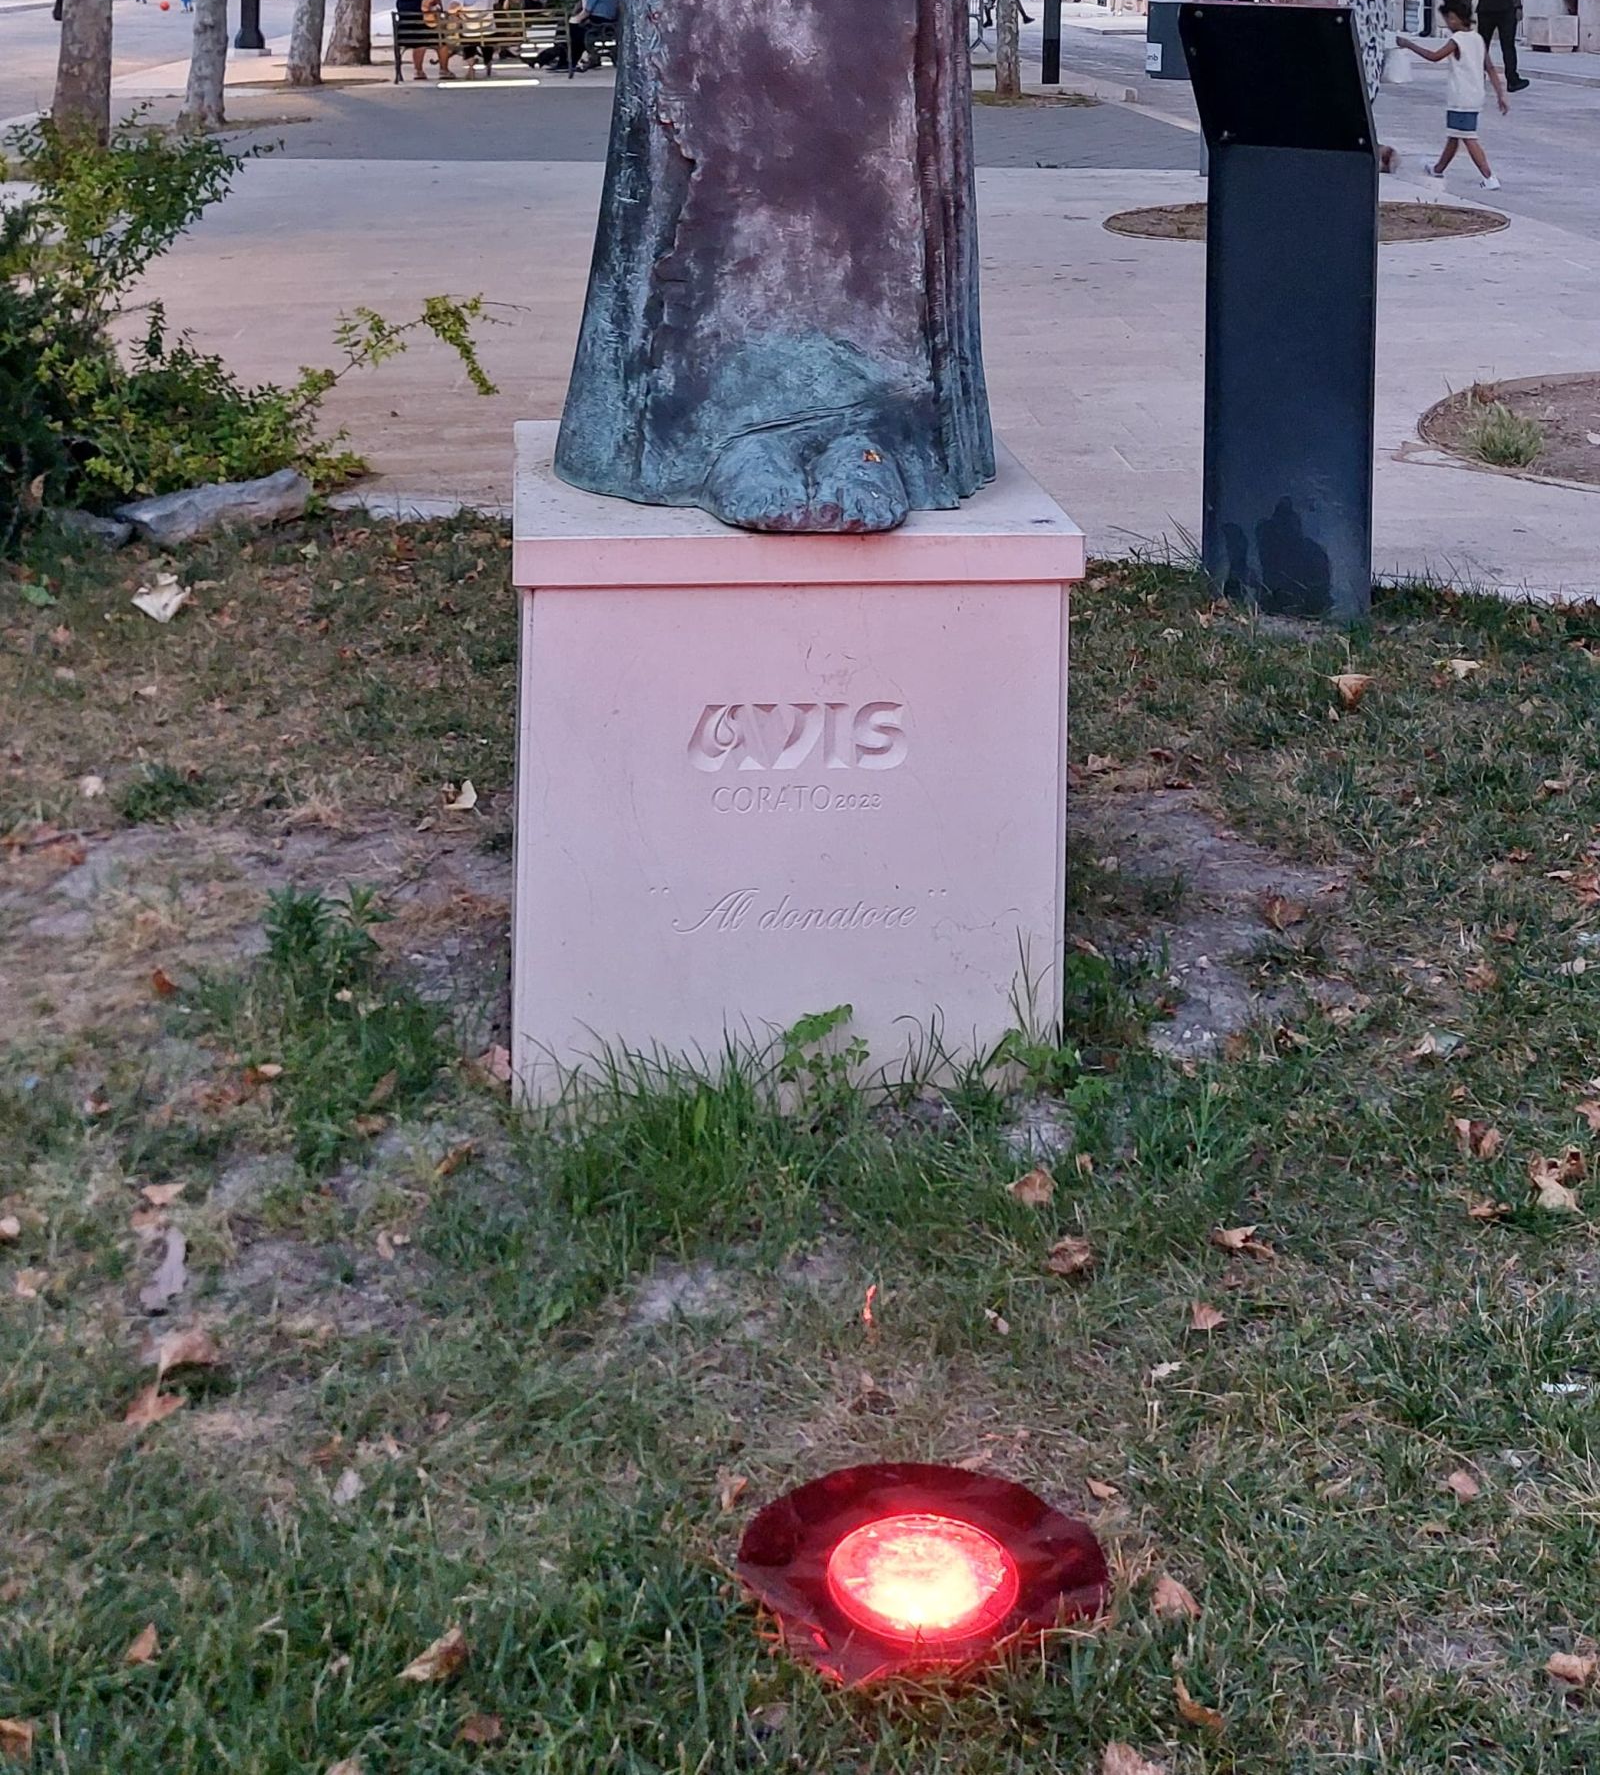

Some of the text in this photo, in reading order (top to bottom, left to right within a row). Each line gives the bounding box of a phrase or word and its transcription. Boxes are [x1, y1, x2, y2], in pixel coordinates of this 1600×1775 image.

[687, 701, 908, 772] AVIS
[711, 784, 882, 813] CORATO 2023
